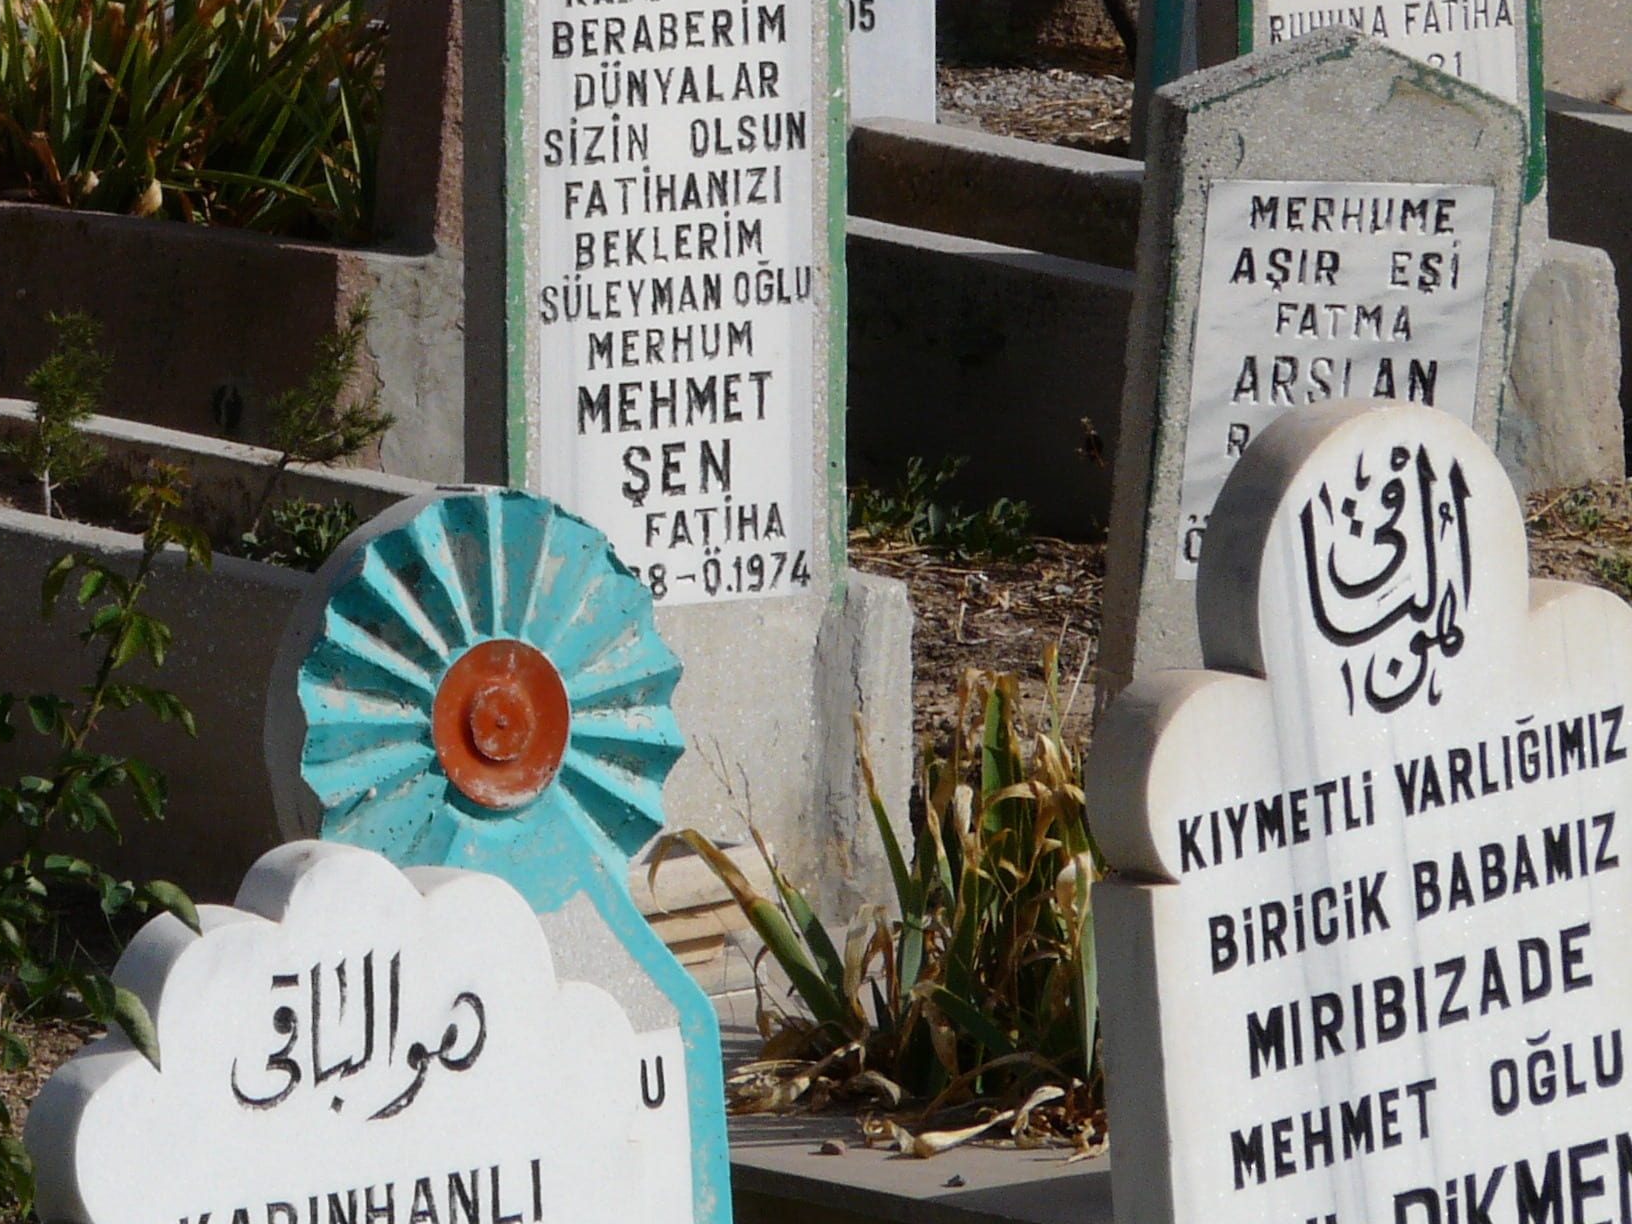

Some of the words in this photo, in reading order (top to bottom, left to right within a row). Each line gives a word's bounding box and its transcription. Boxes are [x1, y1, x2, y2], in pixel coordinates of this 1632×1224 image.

[574, 61, 780, 111] DÜNYALAR
[544, 113, 649, 167] SİZİN
[691, 111, 807, 159] OLSUN
[565, 165, 783, 220] FATİHANIZI
[1251, 196, 1457, 234] MERHUME
[576, 210, 763, 271] BEKLERİM
[1230, 246, 1340, 293] AŞIR
[1389, 239, 1461, 293] EŞİ
[540, 273, 722, 325] SÜLEYMAN
[734, 260, 812, 309] OĞLU
[588, 320, 754, 371] MERHUM
[1274, 302, 1413, 342] FATMA
[578, 370, 772, 434] MEHMET
[621, 438, 732, 507] ŞEN
[646, 495, 786, 548] FATİHA
[1179, 770, 1376, 874] KIYMETLİ
[1395, 704, 1628, 818] VARLIĞIMIZ
[1208, 871, 1391, 975] BİRİCİK
[1412, 811, 1620, 923] BABAMIZ
[1247, 922, 1594, 1080] MIRIBIZADE
[1230, 1077, 1437, 1190] MEHMET
[1490, 1029, 1625, 1118] OĞLU
